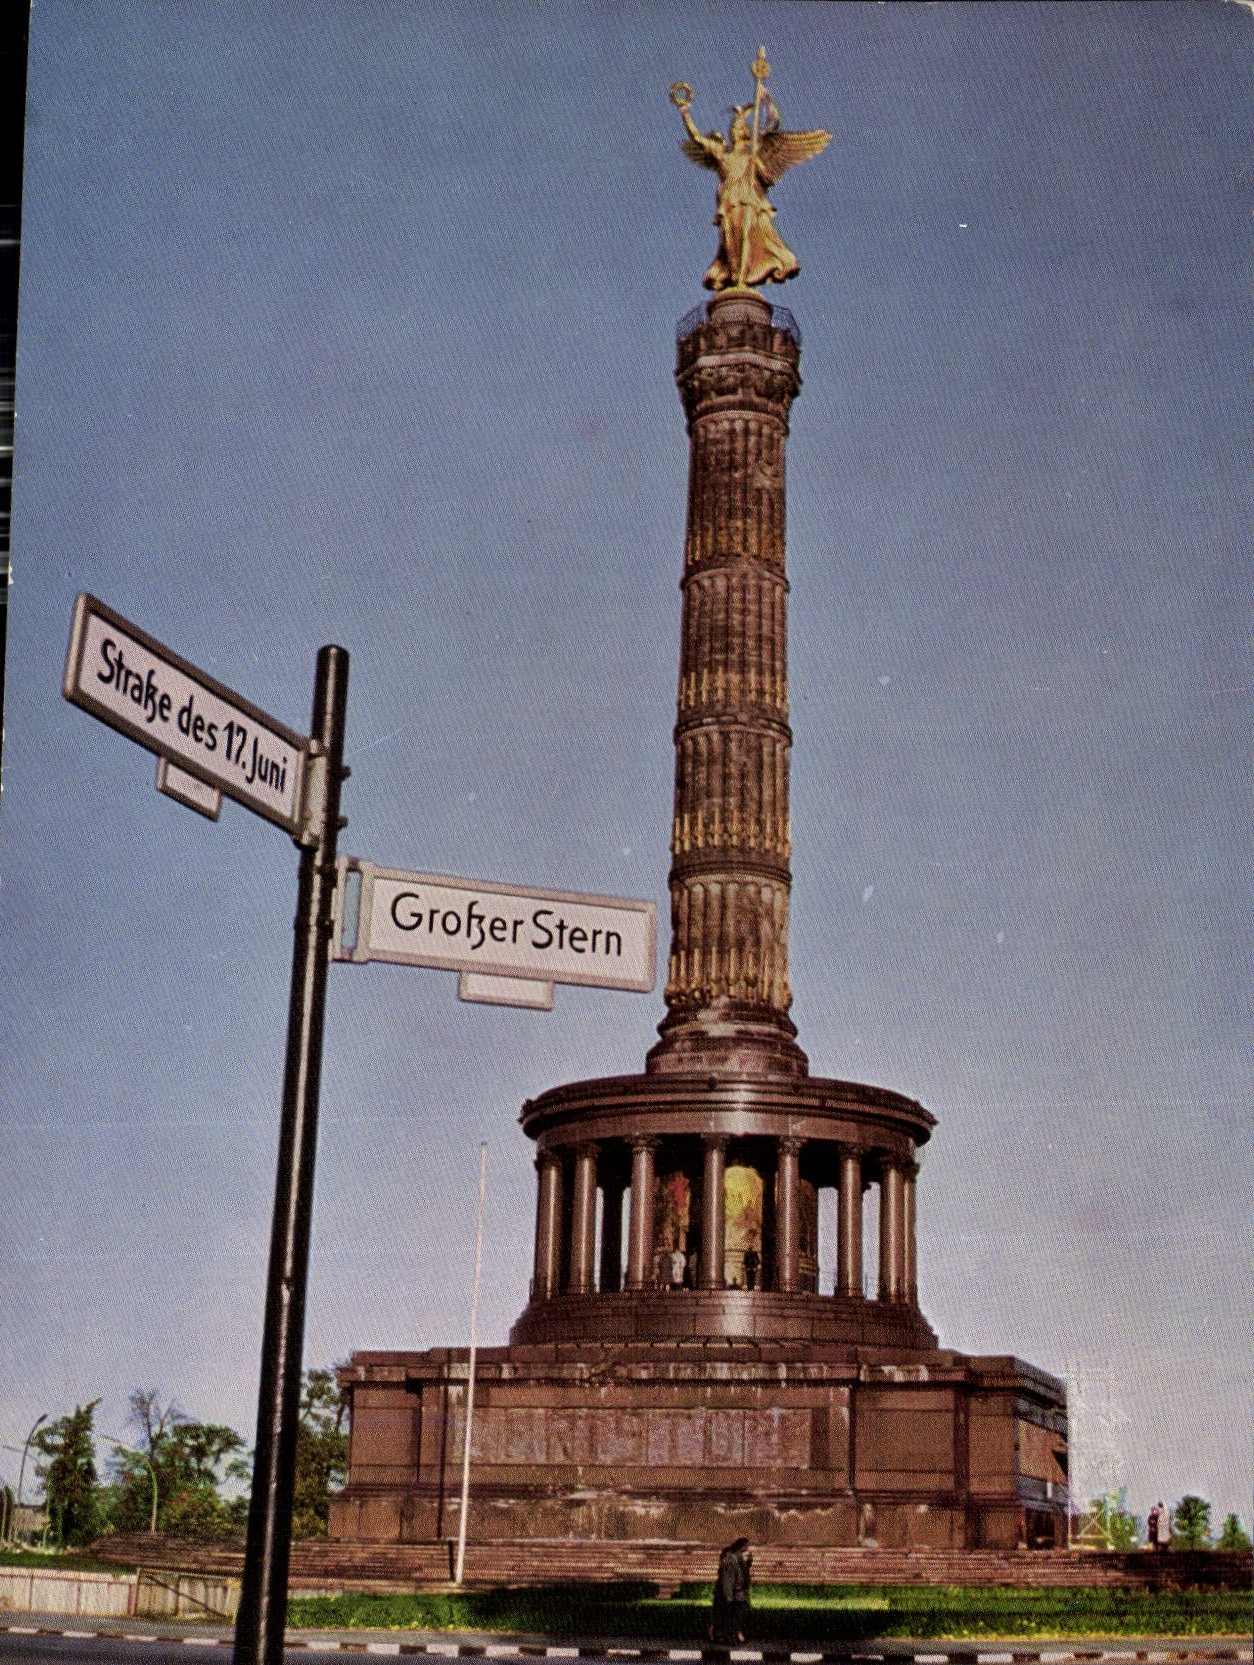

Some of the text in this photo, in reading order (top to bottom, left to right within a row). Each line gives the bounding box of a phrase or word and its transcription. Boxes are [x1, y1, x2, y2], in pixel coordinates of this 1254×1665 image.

[97, 638, 171, 723] Straße
[177, 696, 218, 751] des
[391, 892, 622, 956] Großer Stern
